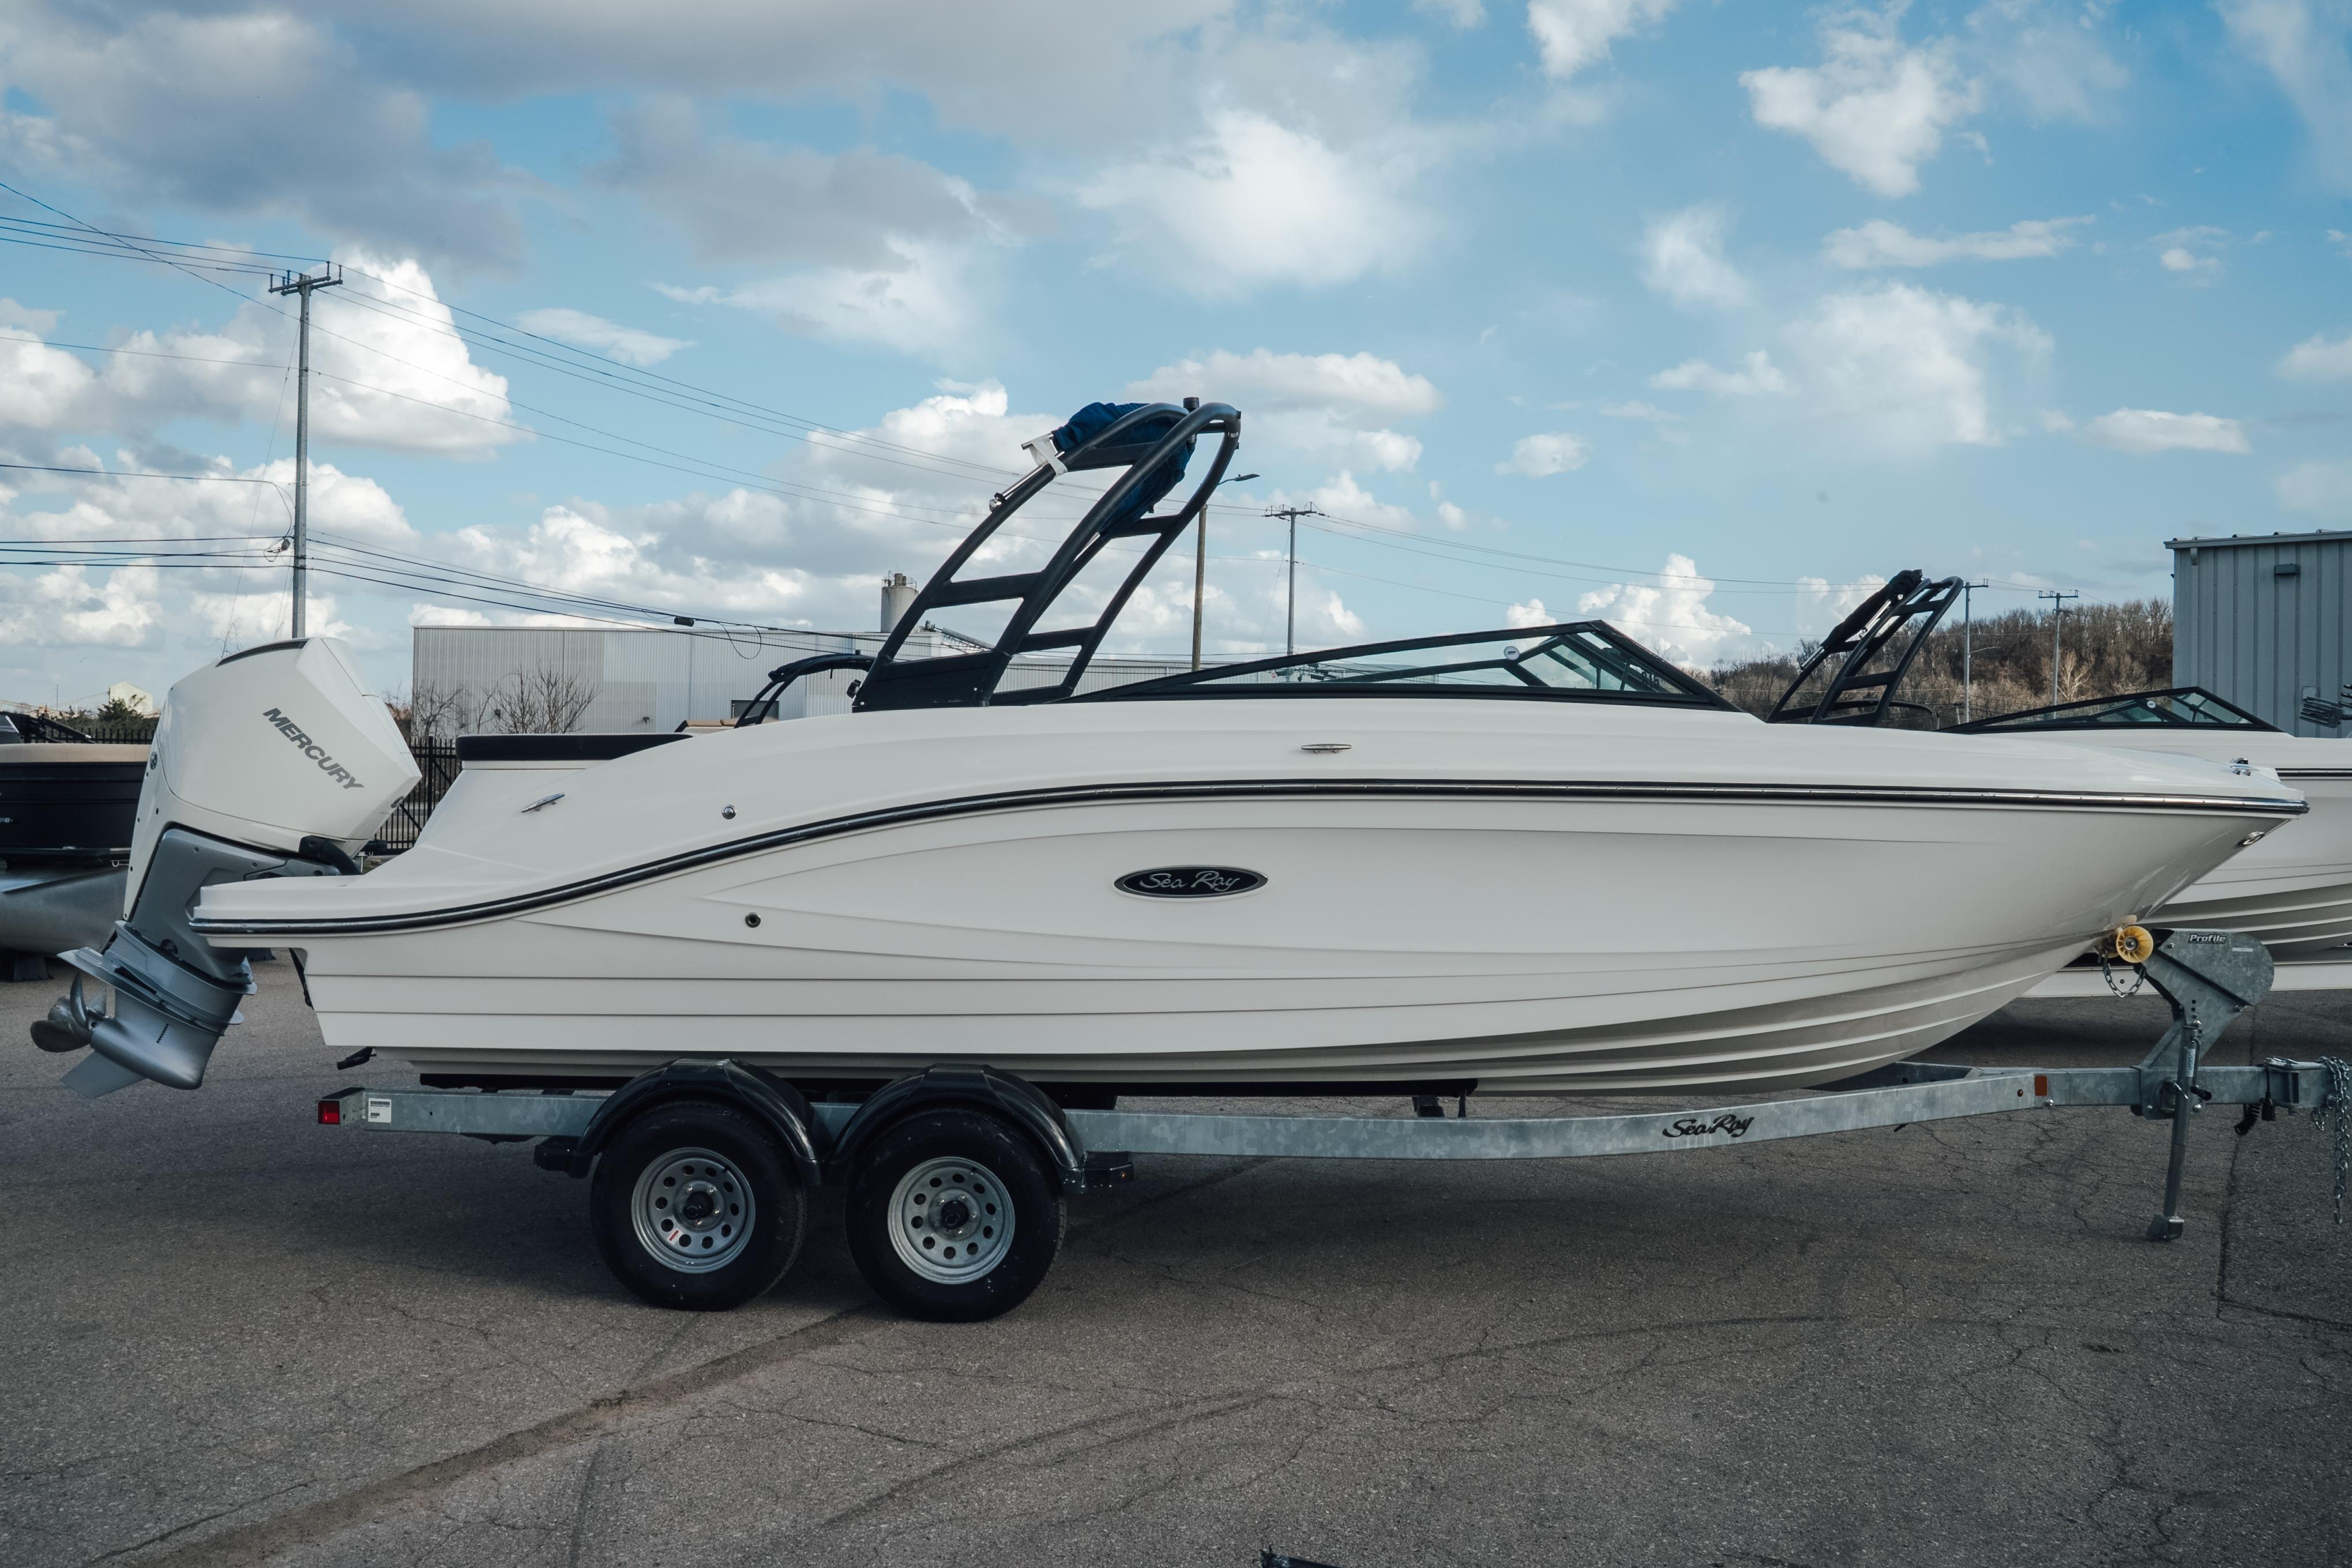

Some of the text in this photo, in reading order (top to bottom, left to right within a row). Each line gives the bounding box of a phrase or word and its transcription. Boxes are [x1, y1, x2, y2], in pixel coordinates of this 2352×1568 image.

[262, 708, 365, 789] MERCURY
[1139, 871, 1240, 892] Sea Ray
[1662, 1114, 1755, 1138] Sea Ray
